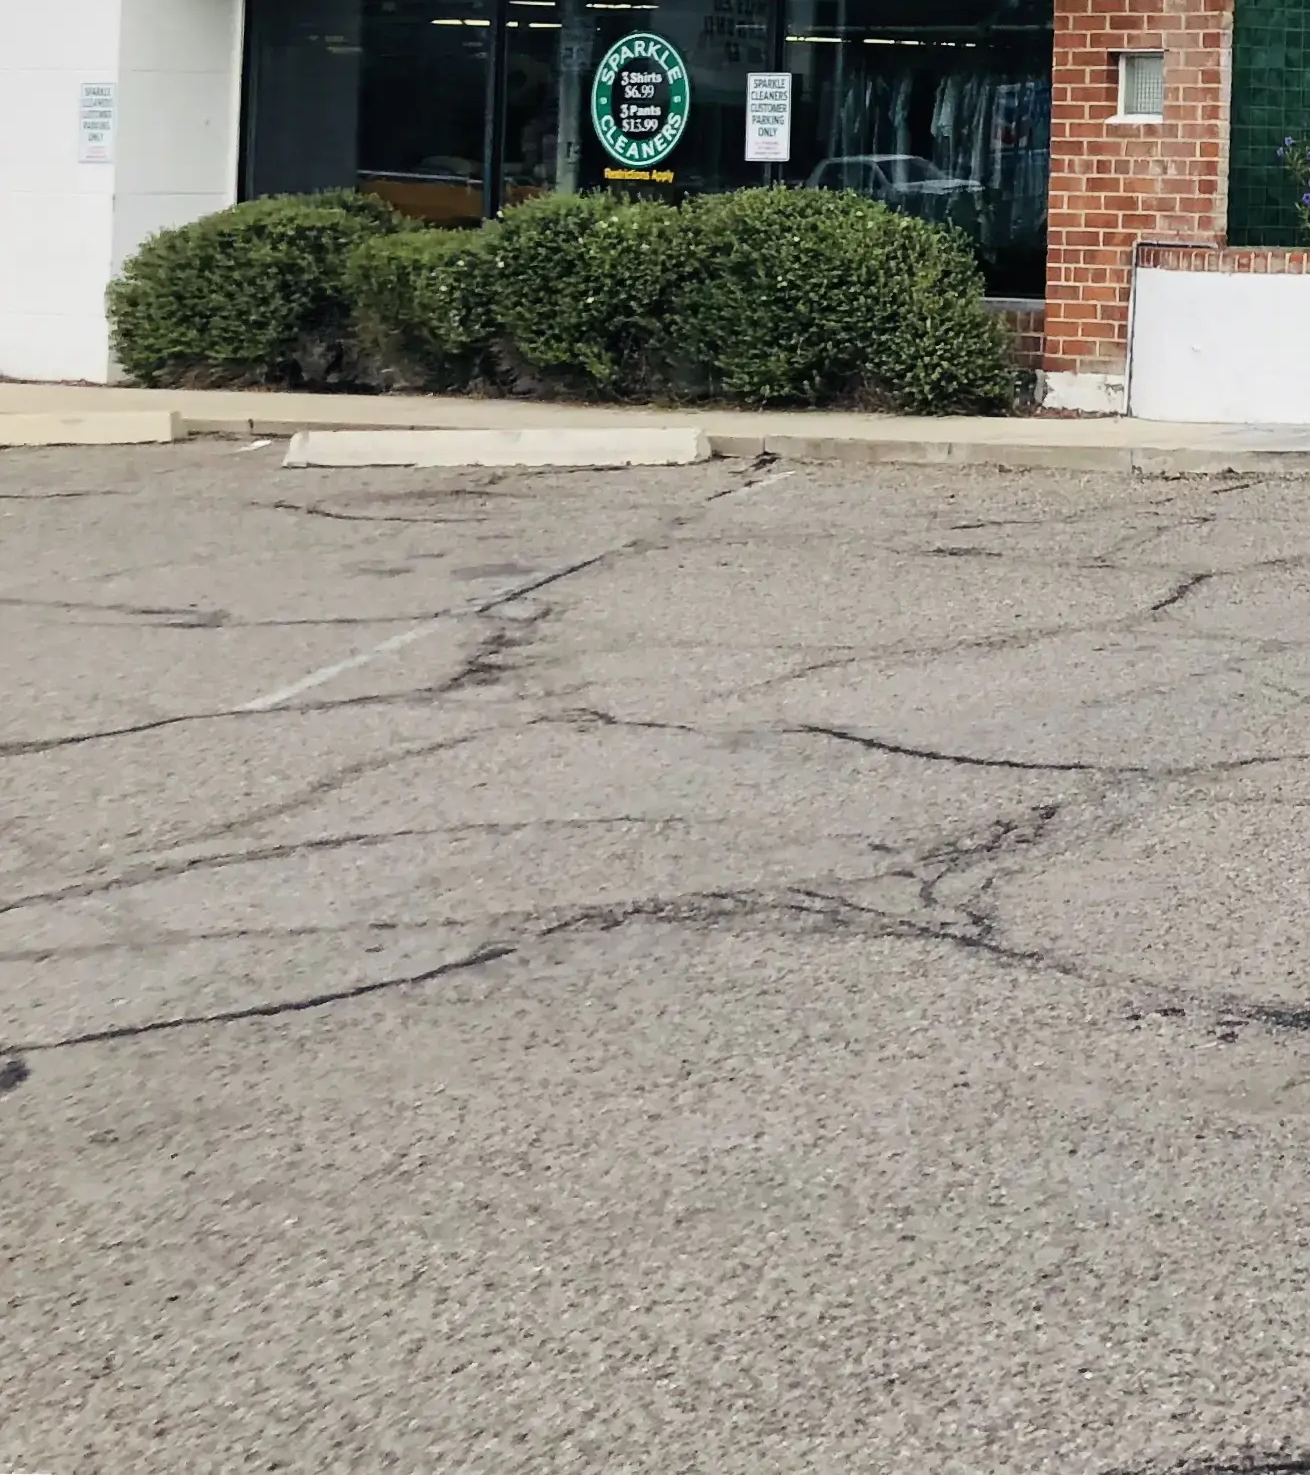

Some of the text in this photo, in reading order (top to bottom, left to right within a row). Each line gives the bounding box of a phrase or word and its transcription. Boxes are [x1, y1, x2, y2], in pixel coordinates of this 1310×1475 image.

[601, 40, 682, 85] SPARKLE
[620, 71, 663, 86] 3 Shirts
[753, 78, 786, 89] SPARKLE
[624, 84, 655, 99] $6.99
[751, 90, 788, 101] CLEANERS
[619, 104, 662, 119] 3 Pants
[750, 103, 787, 113] CUSTOMER
[751, 115, 785, 125] PARKING
[600, 112, 682, 159] CLEANERS
[757, 127, 778, 137] ONLY
[651, 169, 674, 183] Apply
